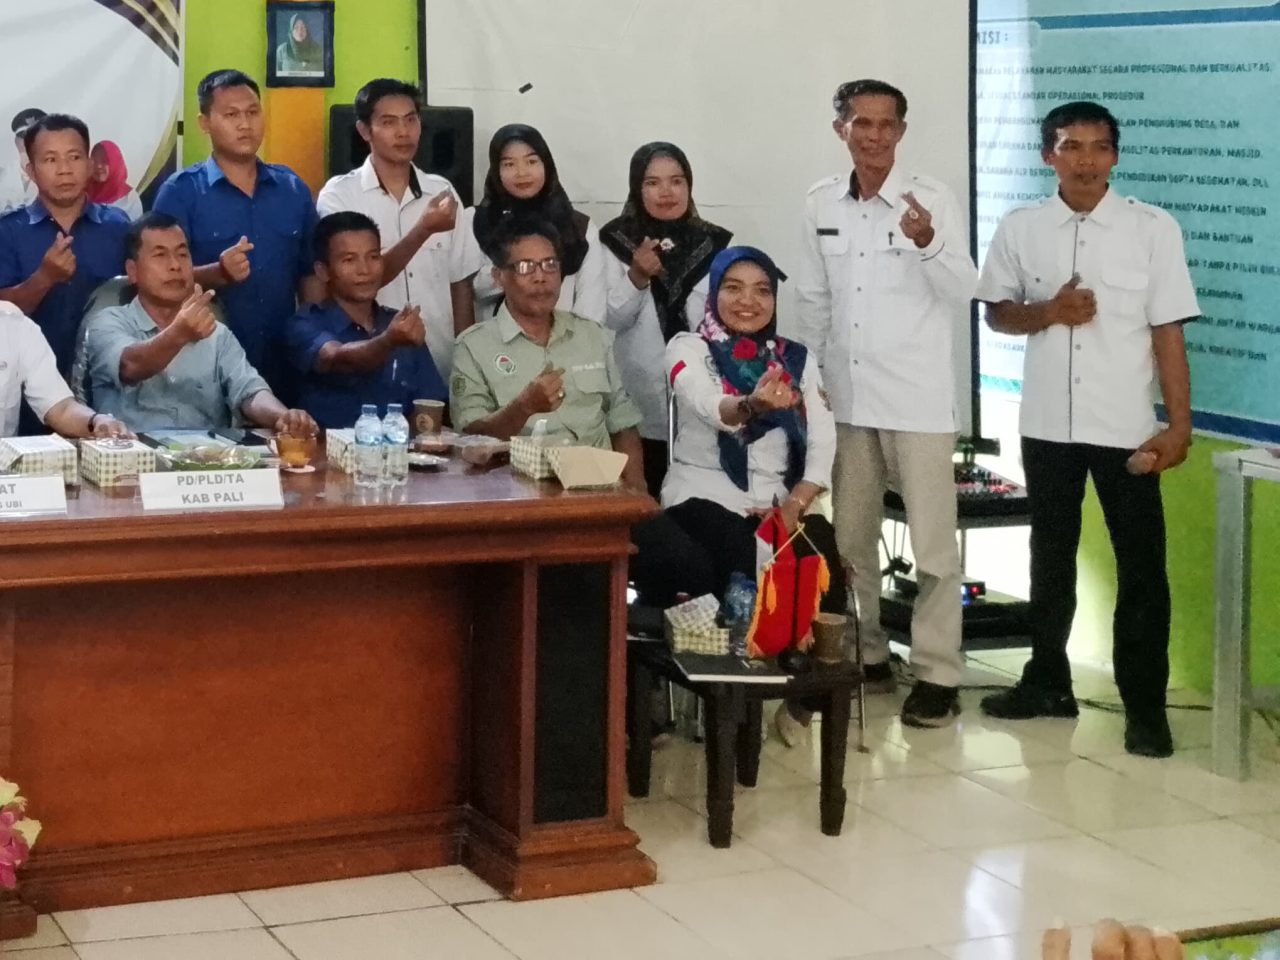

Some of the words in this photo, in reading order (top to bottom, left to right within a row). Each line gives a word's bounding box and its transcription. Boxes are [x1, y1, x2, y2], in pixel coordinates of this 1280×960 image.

[177, 473, 245, 486] PD/PLD/TA
[182, 493, 210, 504] KAB
[214, 492, 244, 503] PALI
[6, 500, 22, 509] UBI
